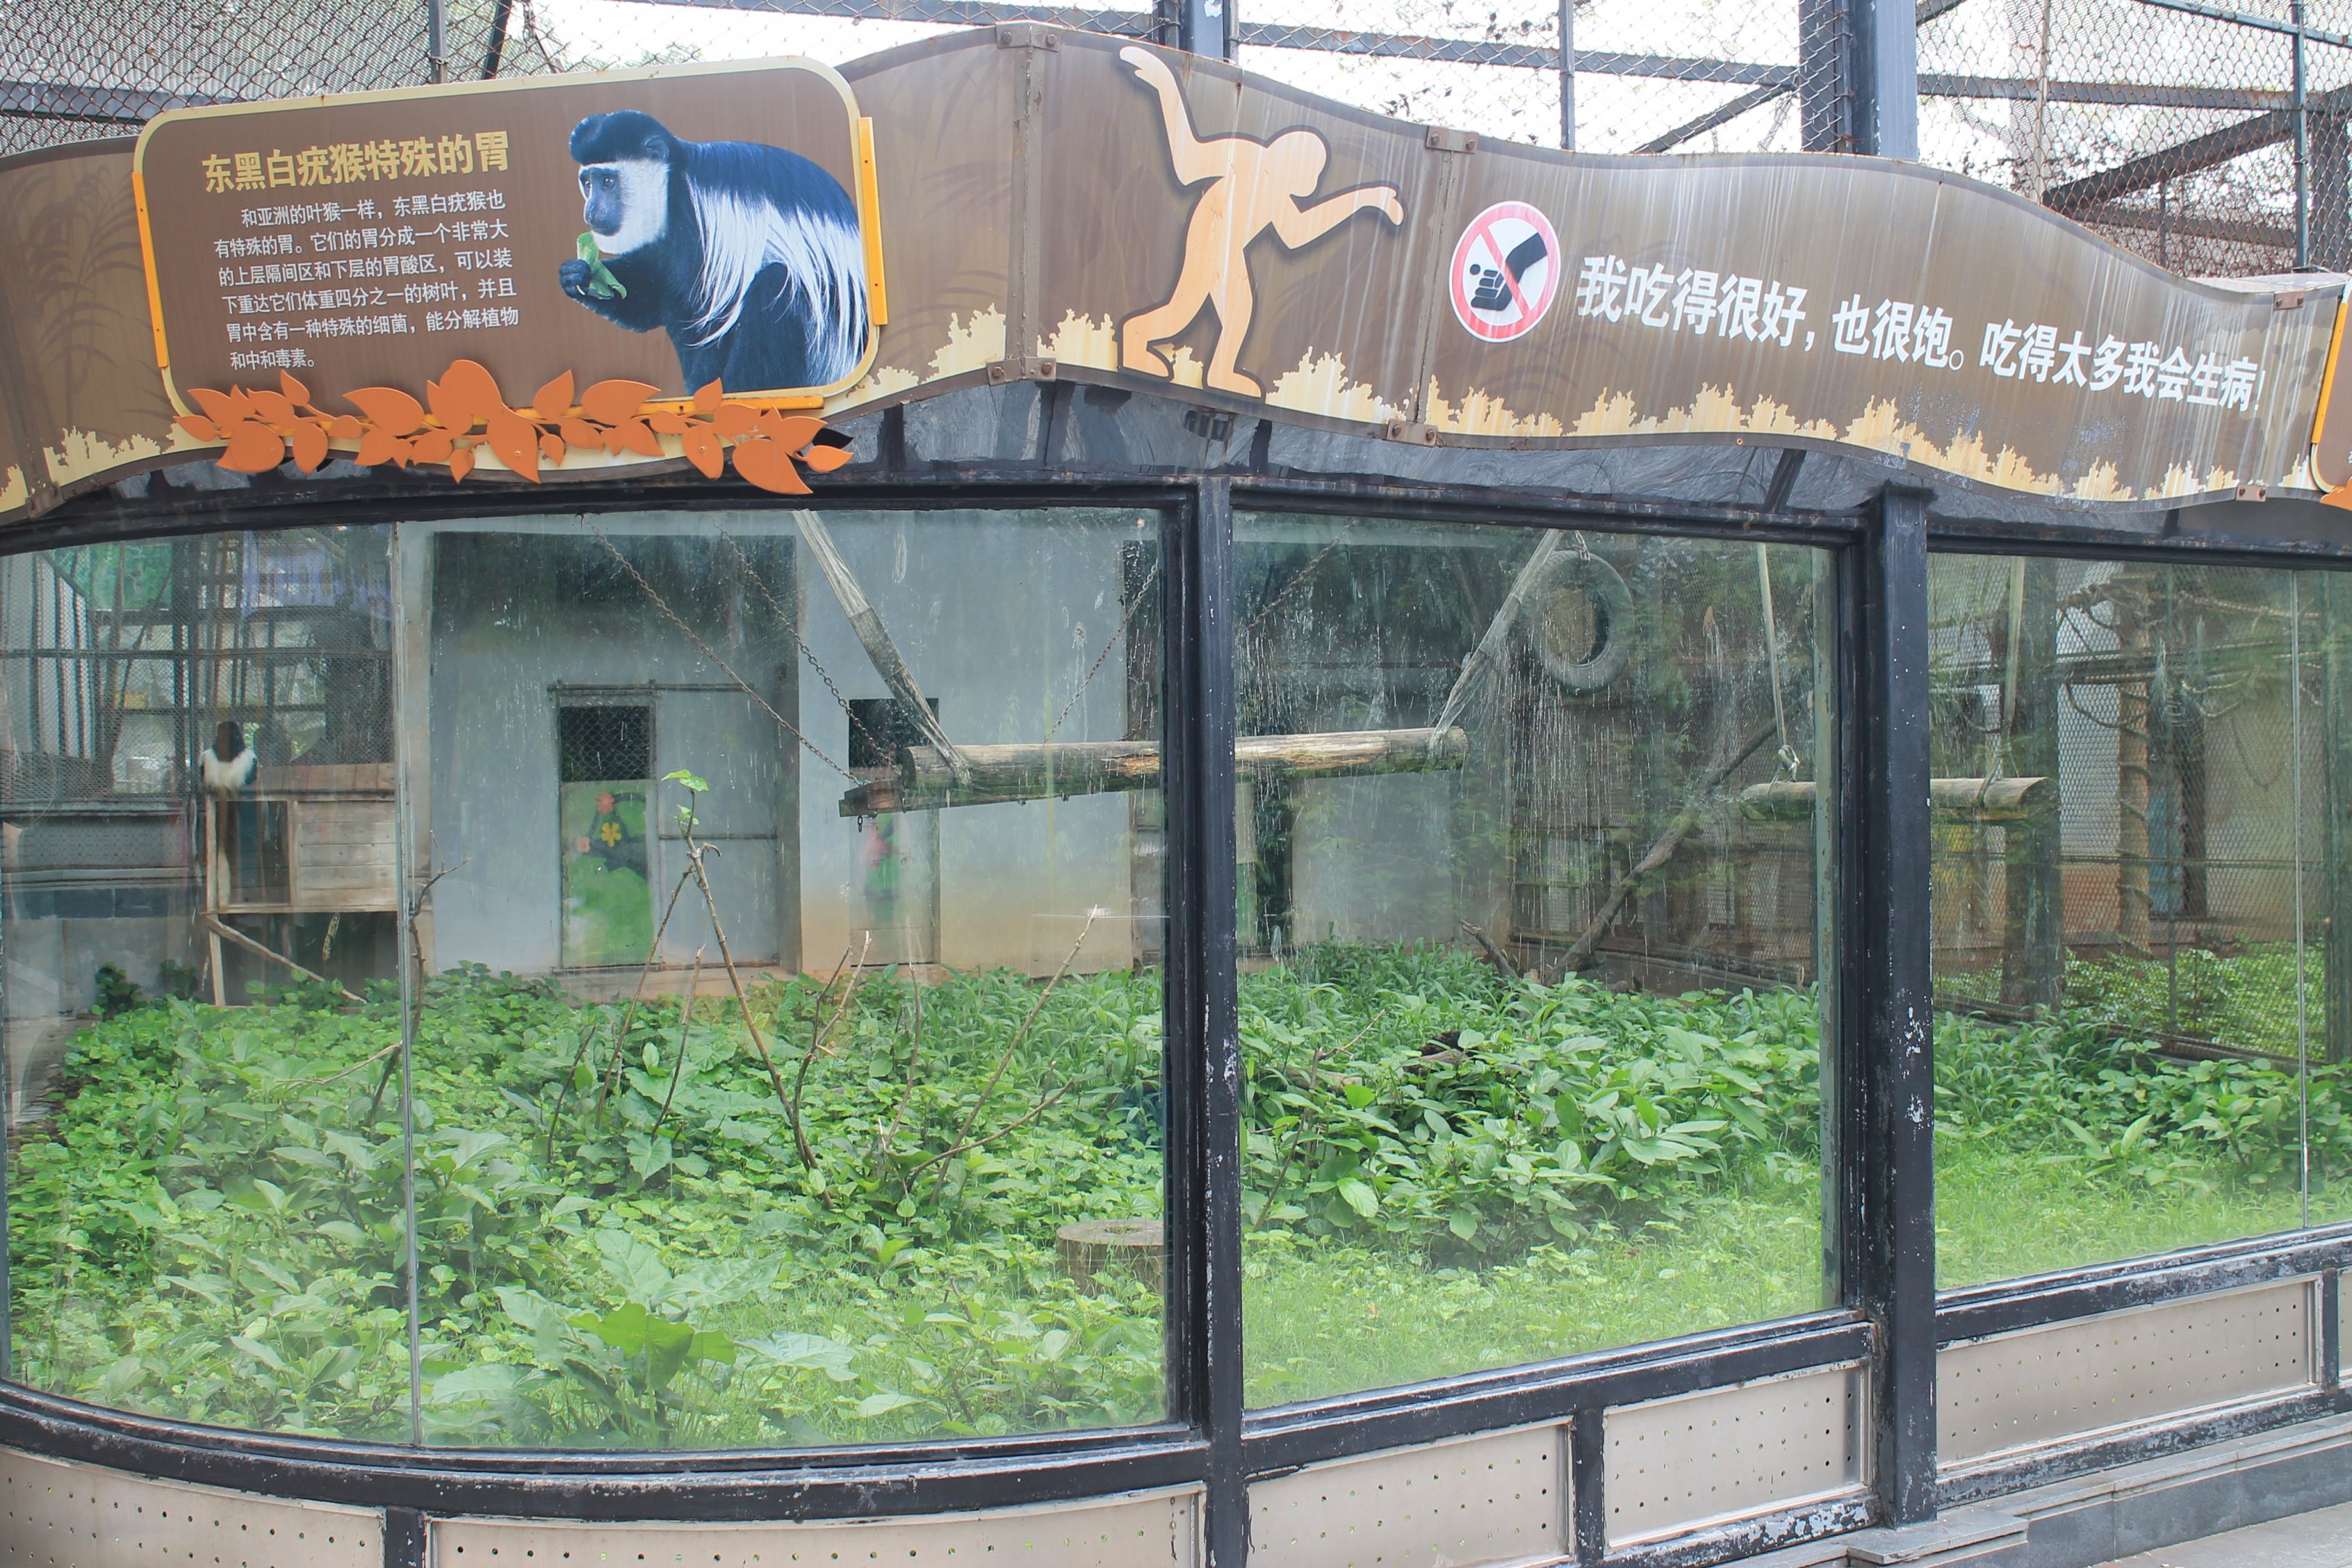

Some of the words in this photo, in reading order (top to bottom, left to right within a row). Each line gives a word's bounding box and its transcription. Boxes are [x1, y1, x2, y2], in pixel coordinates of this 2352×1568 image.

[202, 131, 509, 194] 东黑白疣猴特殊的胃
[241, 189, 506, 228] 和亚洲的叶猴一样，东黑白疣猴也
[213, 219, 510, 258] 有特殊的胃。它们的胃分成一个非常大
[219, 248, 513, 287] 的上层隔间区和下层的胃酸区，可以装
[221, 277, 518, 314] 下重达它们体重四分之一的树叶，并且
[226, 306, 519, 343] 胃中含有一种特殊的细菌，能分解植物
[229, 348, 314, 371] 和中和毒素。
